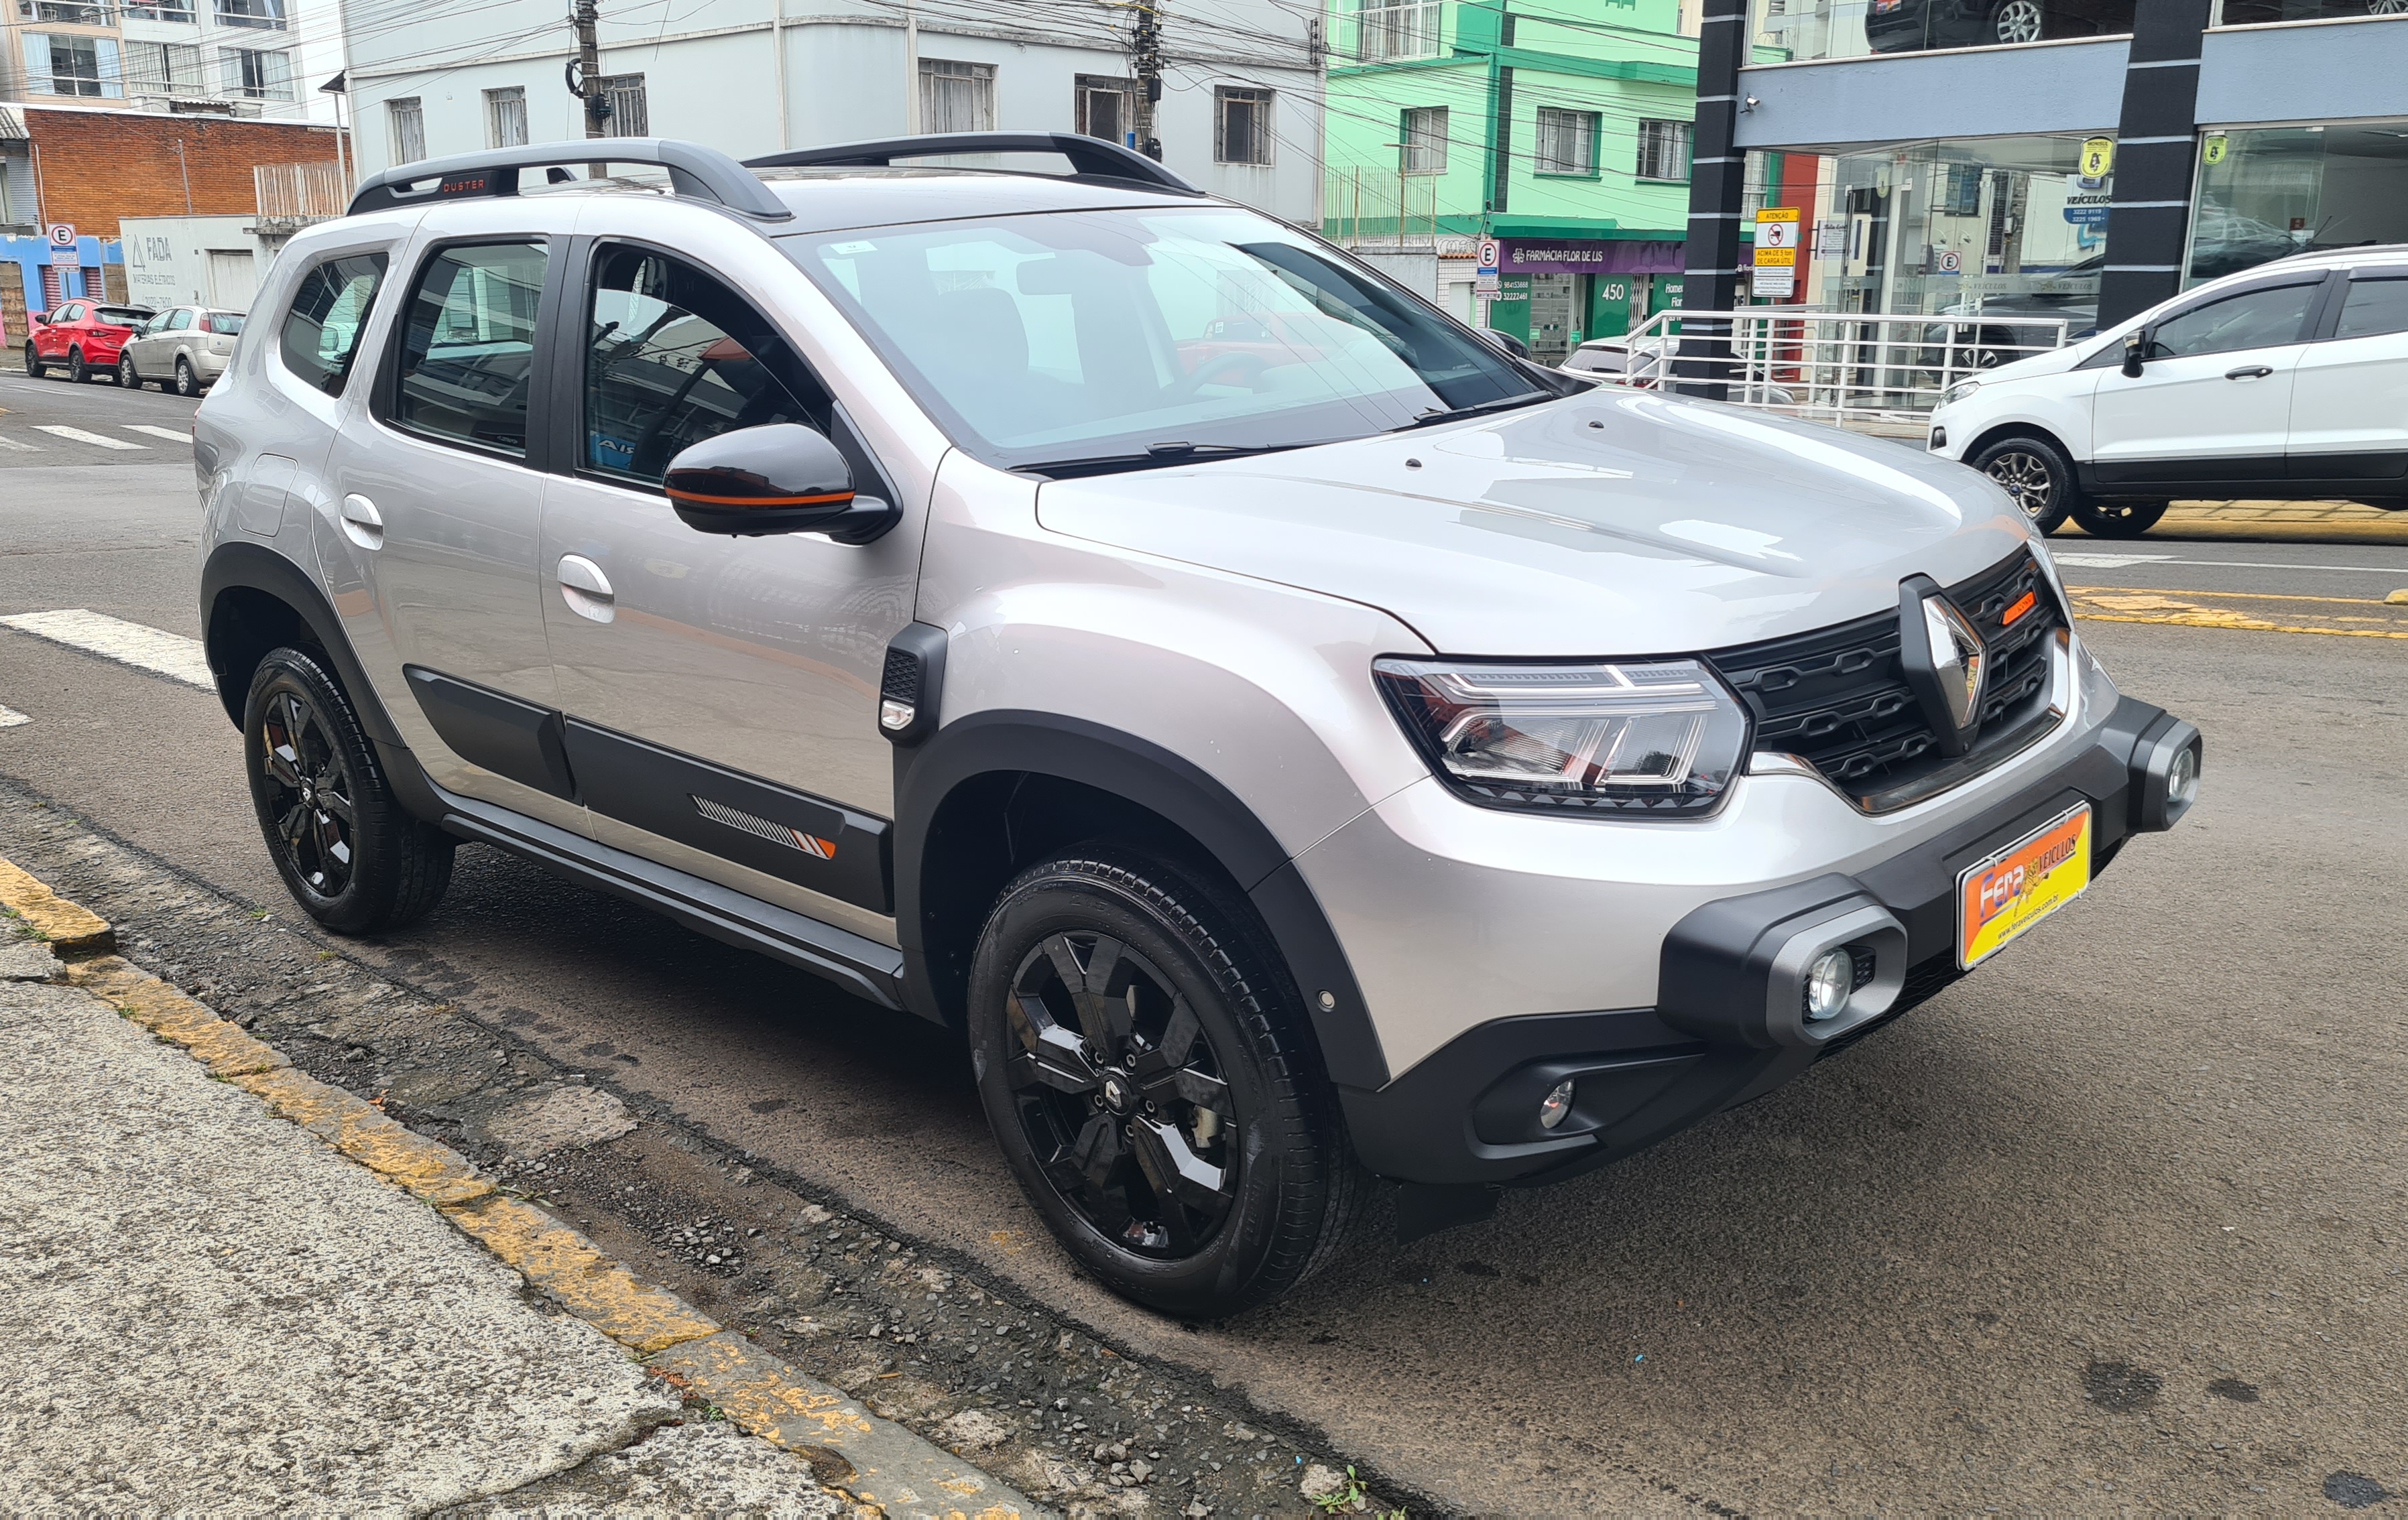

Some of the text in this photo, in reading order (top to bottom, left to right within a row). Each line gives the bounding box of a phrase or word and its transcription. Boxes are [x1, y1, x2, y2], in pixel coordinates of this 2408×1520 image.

[444, 179, 485, 193] DUSTER
[2067, 193, 2112, 204] VEÍCULOS
[1766, 211, 1789, 220] ATENÇÃO
[58, 230, 67, 241] E
[146, 237, 172, 261] FADA
[1484, 247, 1492, 262] E
[1526, 247, 1603, 262] FARMÁCIA FLOR DE LIS
[1602, 283, 1624, 300] 450
[1980, 865, 2025, 917] Fera
